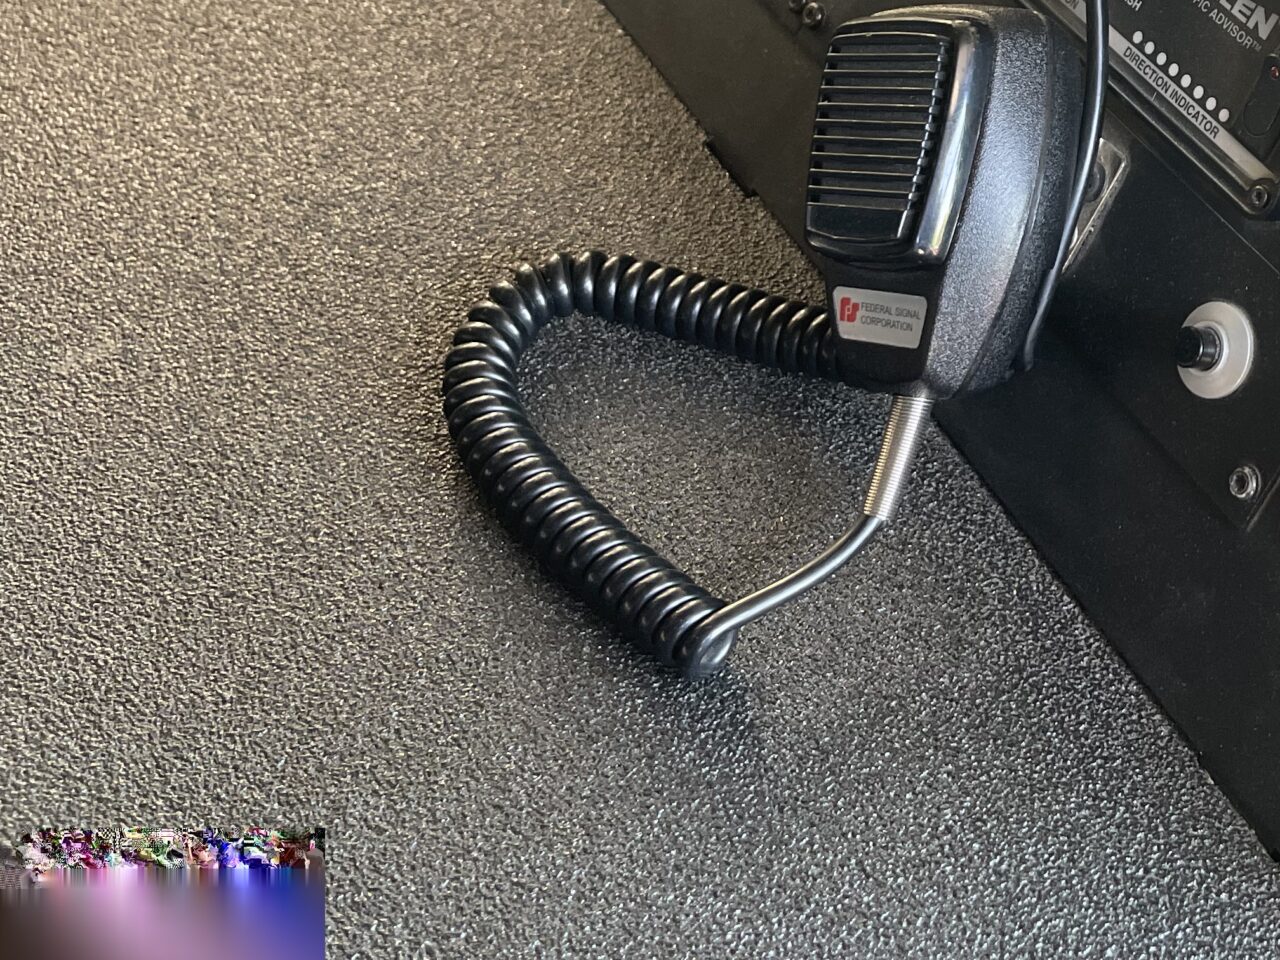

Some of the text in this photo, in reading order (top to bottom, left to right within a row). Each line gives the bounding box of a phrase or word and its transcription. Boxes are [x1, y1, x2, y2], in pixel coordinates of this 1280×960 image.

[1123, 46, 1220, 140] DIRECTION INDICATOR
[861, 302, 922, 321] FEDERAL SIGNAL
[860, 315, 913, 332] CORPORATION
